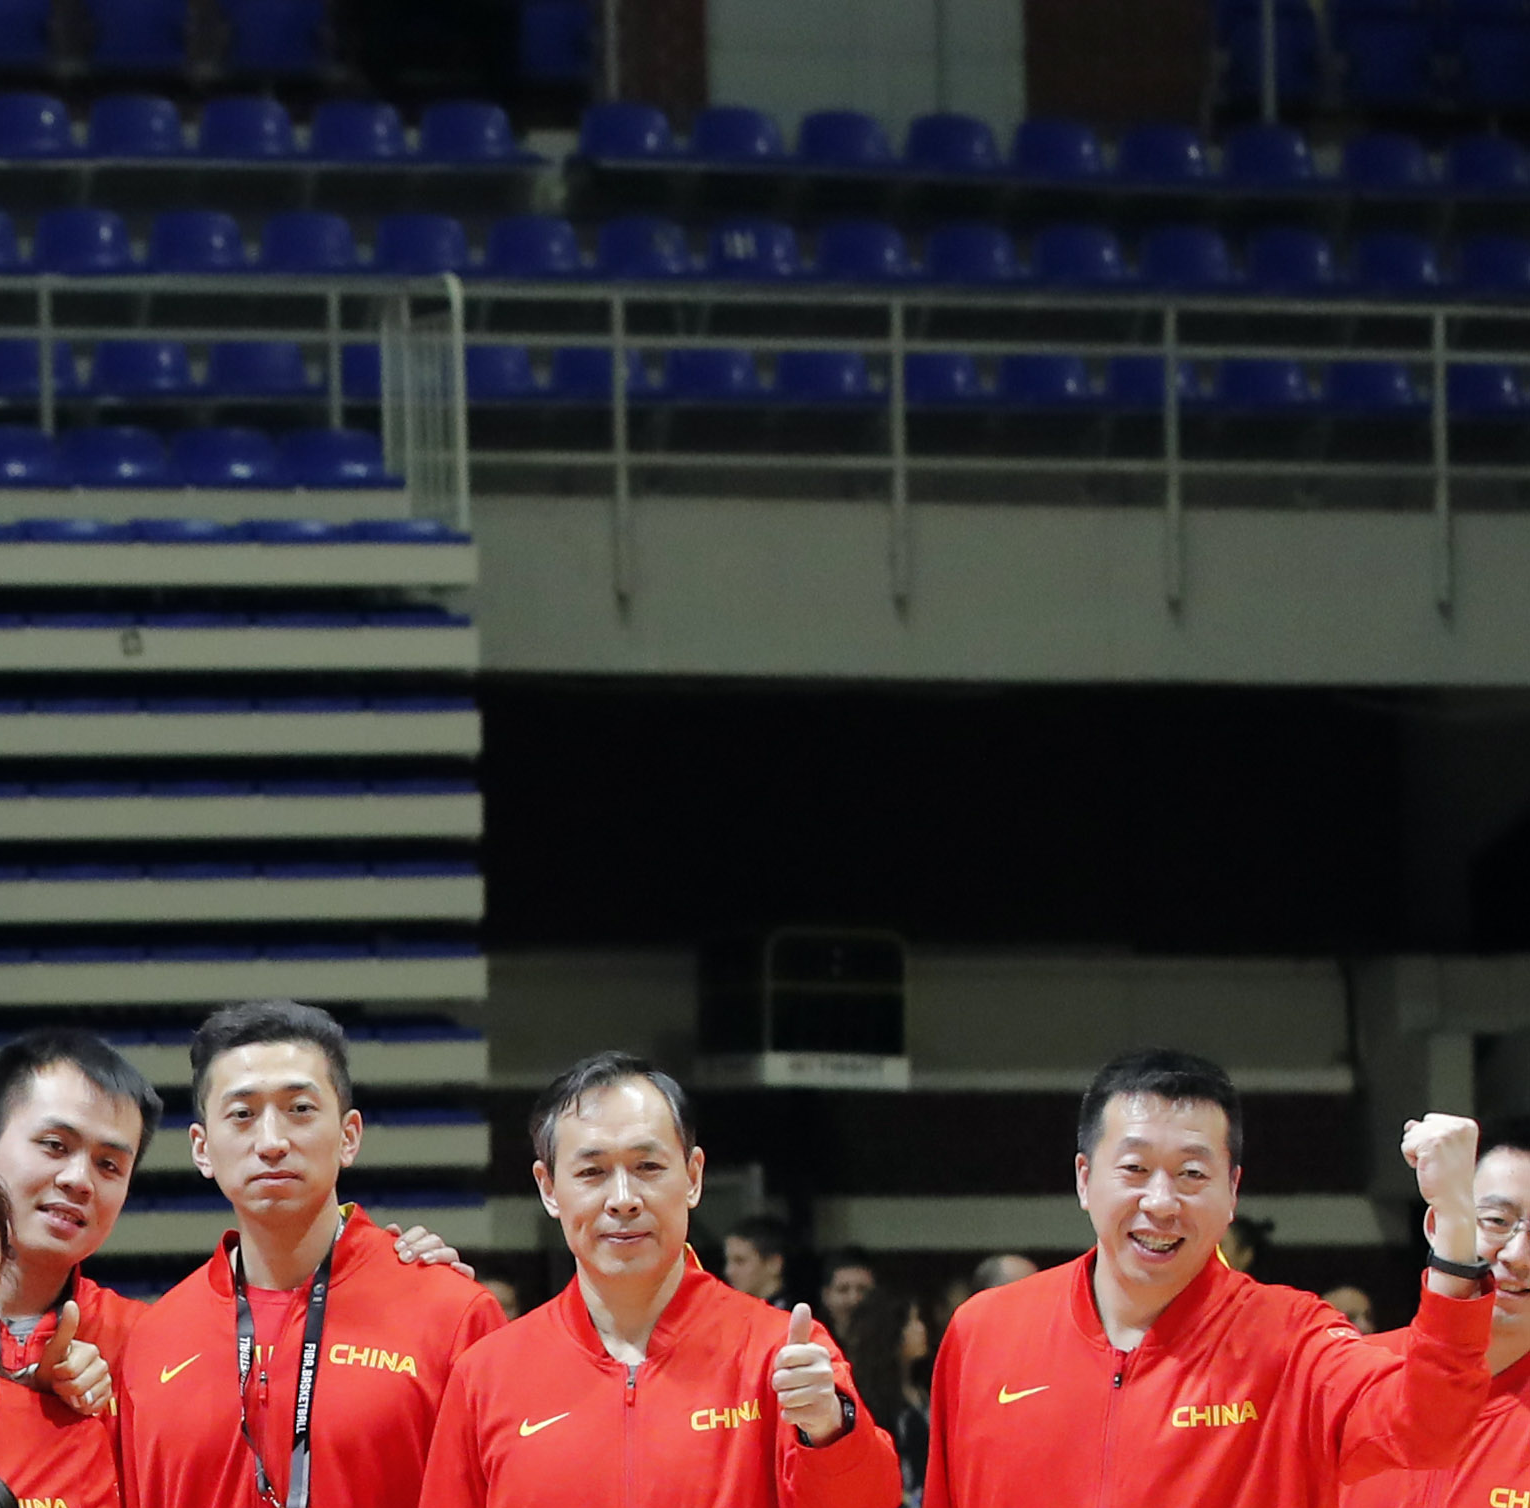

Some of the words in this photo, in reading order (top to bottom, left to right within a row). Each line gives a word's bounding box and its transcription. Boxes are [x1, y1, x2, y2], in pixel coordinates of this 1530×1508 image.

[329, 1343, 418, 1378] CHINA
[295, 1343, 317, 1434] FIBA.BASKETBALL
[1171, 1401, 1258, 1428] CHINA
